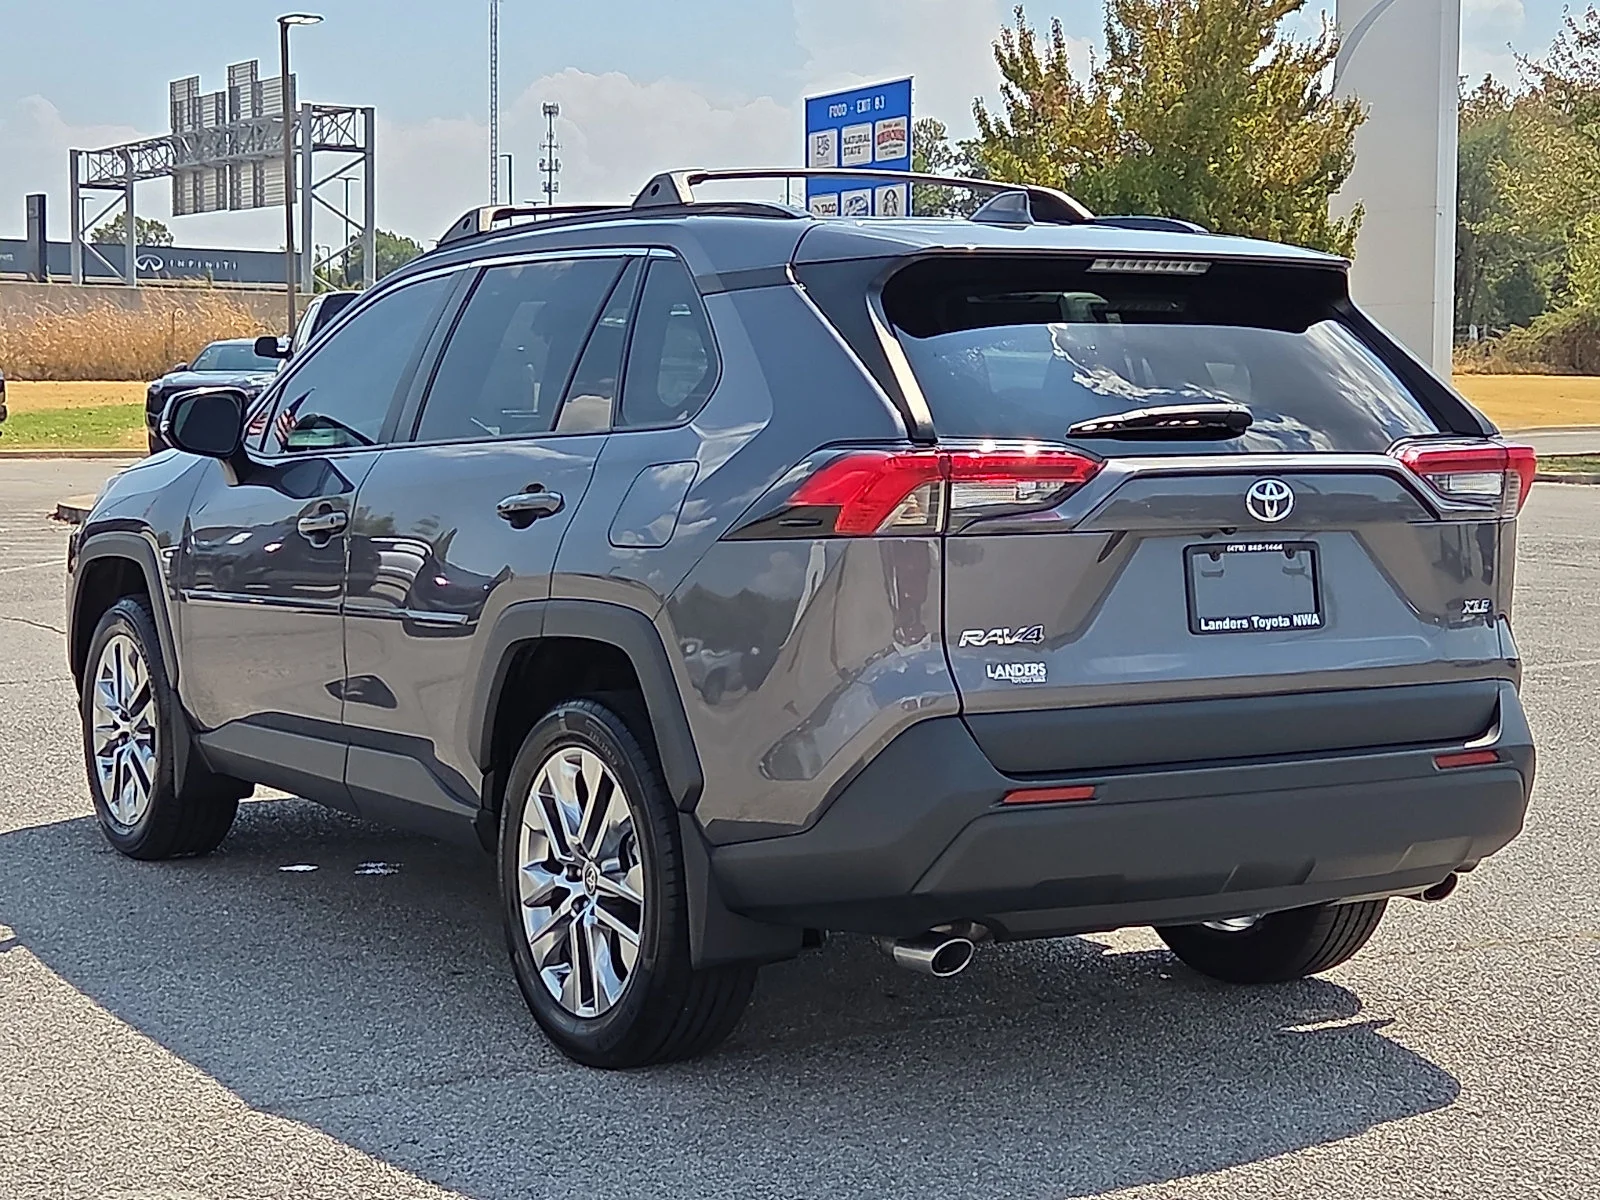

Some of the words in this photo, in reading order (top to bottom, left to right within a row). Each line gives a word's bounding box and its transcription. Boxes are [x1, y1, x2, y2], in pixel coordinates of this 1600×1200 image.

[828, 103, 848, 118] FOOD
[856, 98, 871, 114] EXIT
[843, 134, 871, 146] NATURAL
[843, 145, 863, 157] STATE
[168, 258, 239, 271] INFINITI
[1461, 599, 1490, 614] XLE
[1200, 617, 1249, 631] Landers
[1251, 615, 1290, 631] Toyota
[1293, 613, 1321, 627] NWA
[958, 625, 1045, 648] RAV4
[986, 663, 1047, 680] LANDERS
